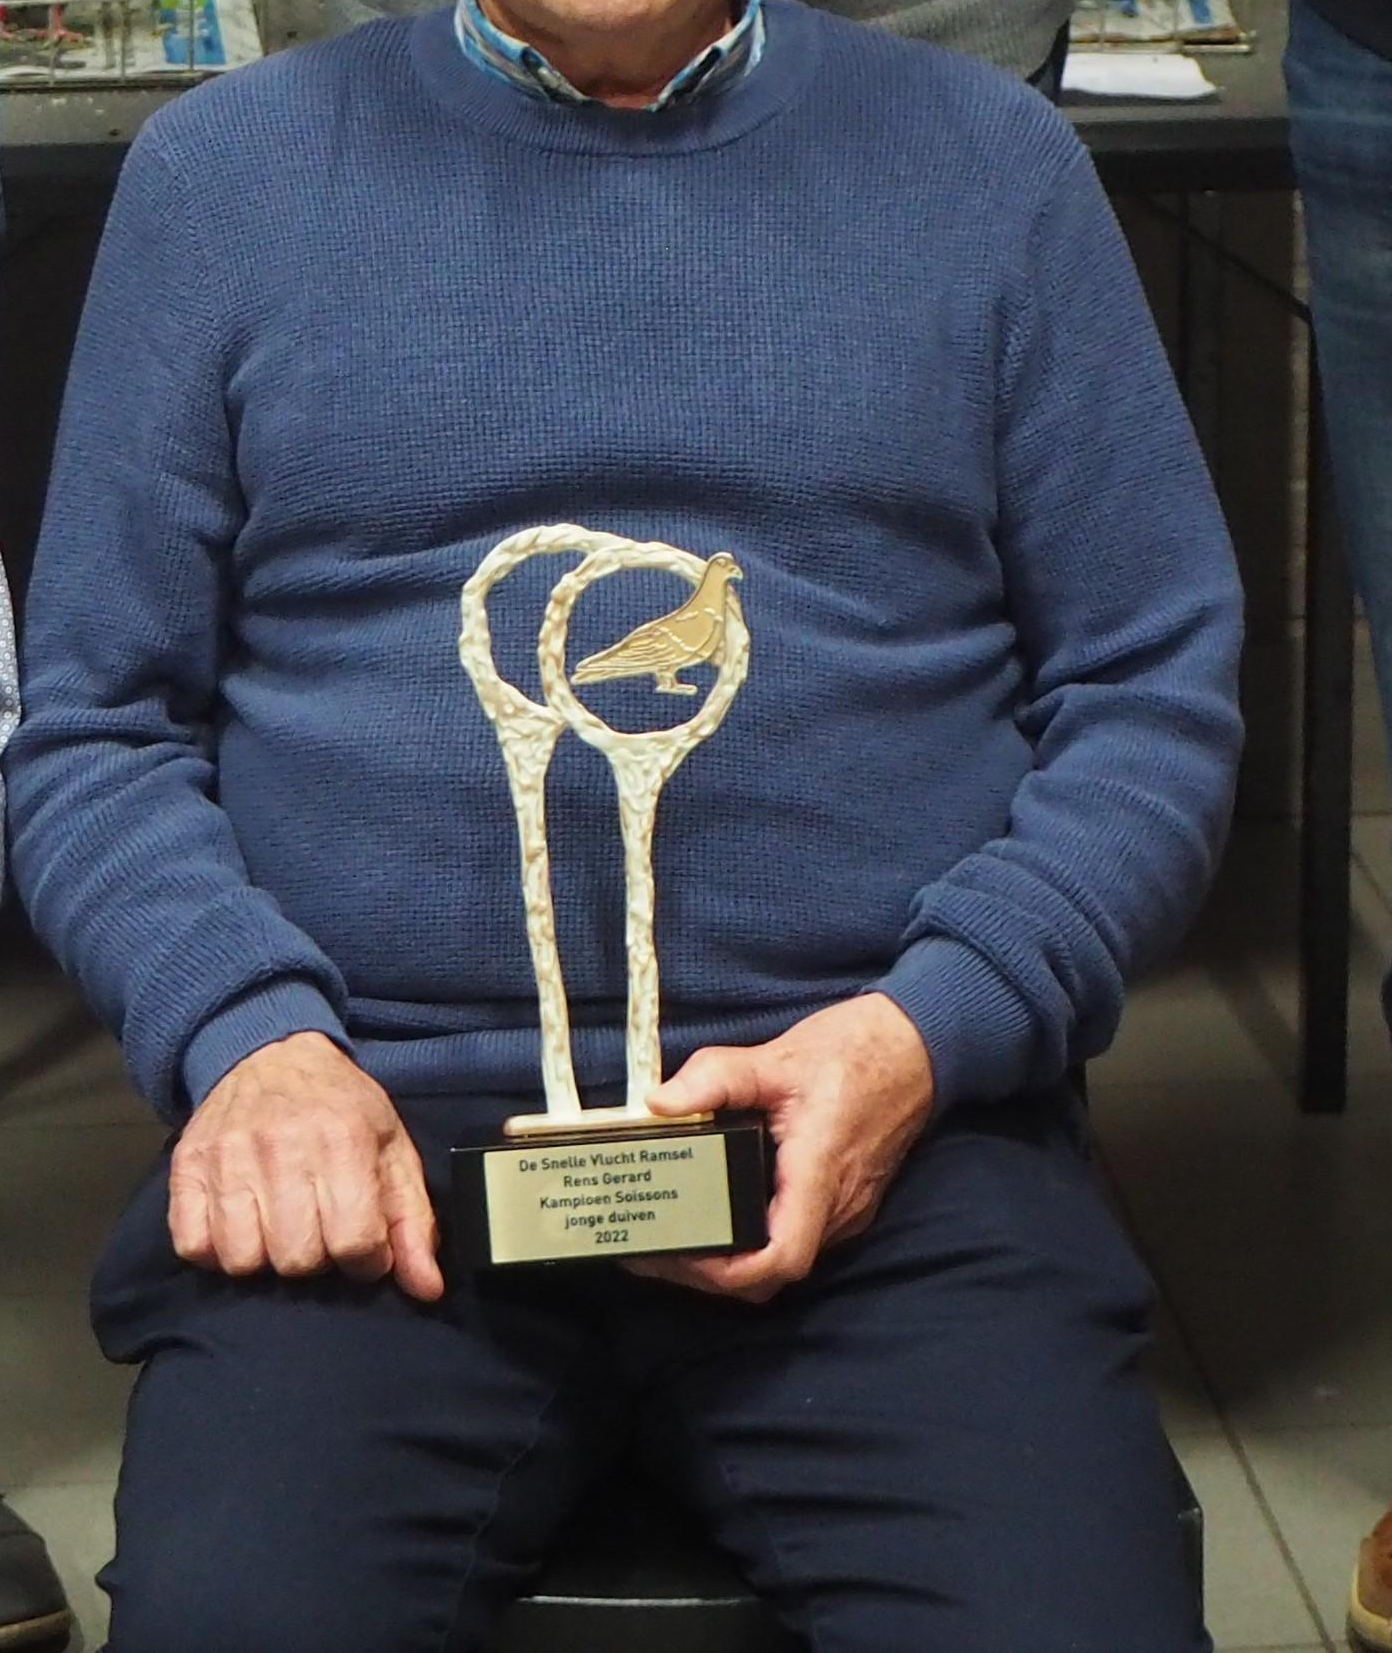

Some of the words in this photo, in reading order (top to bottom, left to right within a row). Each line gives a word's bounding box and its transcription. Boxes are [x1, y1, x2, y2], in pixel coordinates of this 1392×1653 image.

[519, 1159, 537, 1172] De
[541, 1155, 586, 1170] Snelle
[590, 1151, 636, 1166] Vlucht
[639, 1147, 694, 1163] Ramsel
[563, 1174, 599, 1187] Rens
[602, 1169, 652, 1185] Gerard
[539, 1193, 611, 1209] Kampioen
[615, 1188, 679, 1203] Soissons
[564, 1213, 604, 1230] jonge
[608, 1210, 656, 1224] duiven
[595, 1229, 629, 1244] 2022
